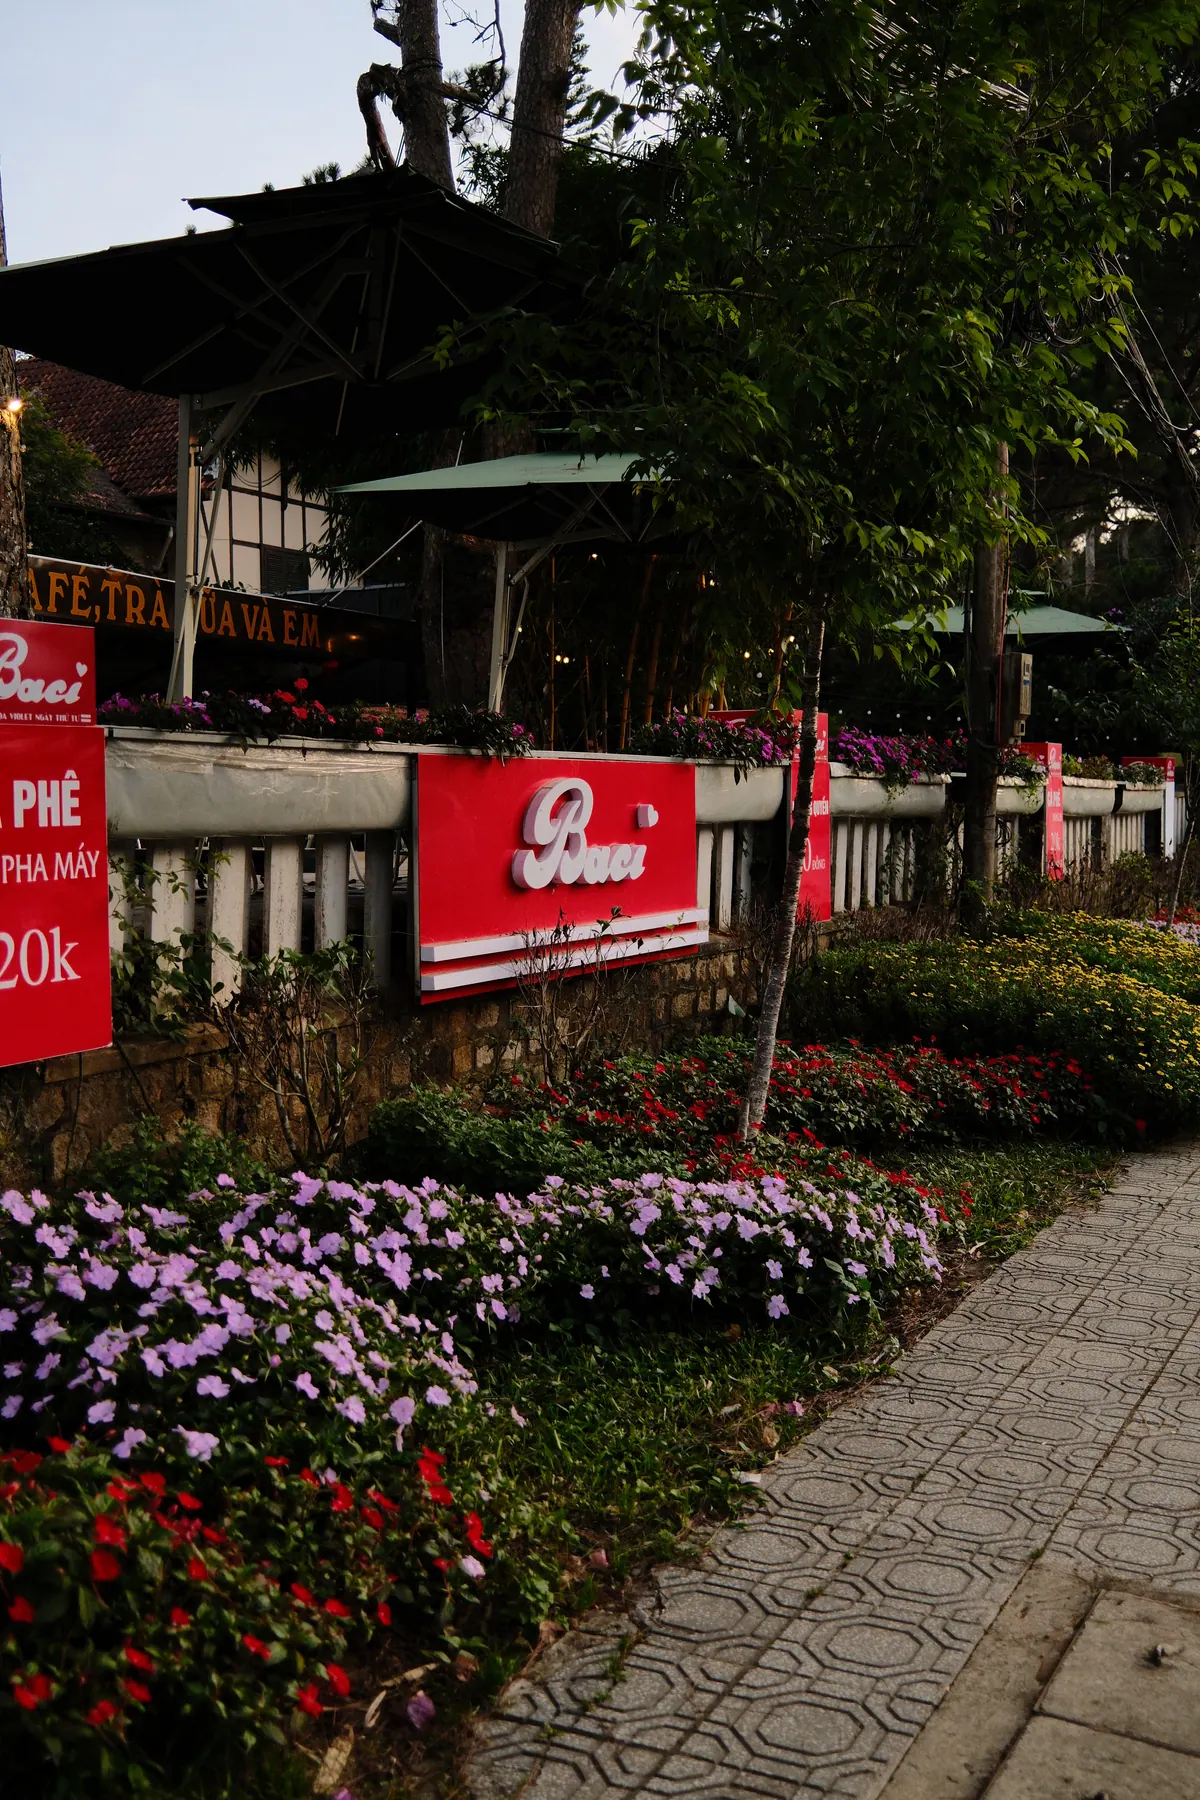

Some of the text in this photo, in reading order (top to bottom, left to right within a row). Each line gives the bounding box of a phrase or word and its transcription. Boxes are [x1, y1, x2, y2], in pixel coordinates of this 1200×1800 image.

[194, 587, 237, 637] ỮA
[241, 597, 275, 642] VÀ
[283, 609, 320, 648] EM
[9, 712, 33, 721] VIOLET
[13, 770, 81, 828] PHÊ
[2, 842, 100, 884] PHA MÁY
[511, 777, 658, 890] Baci
[0, 926, 81, 990] 20k
